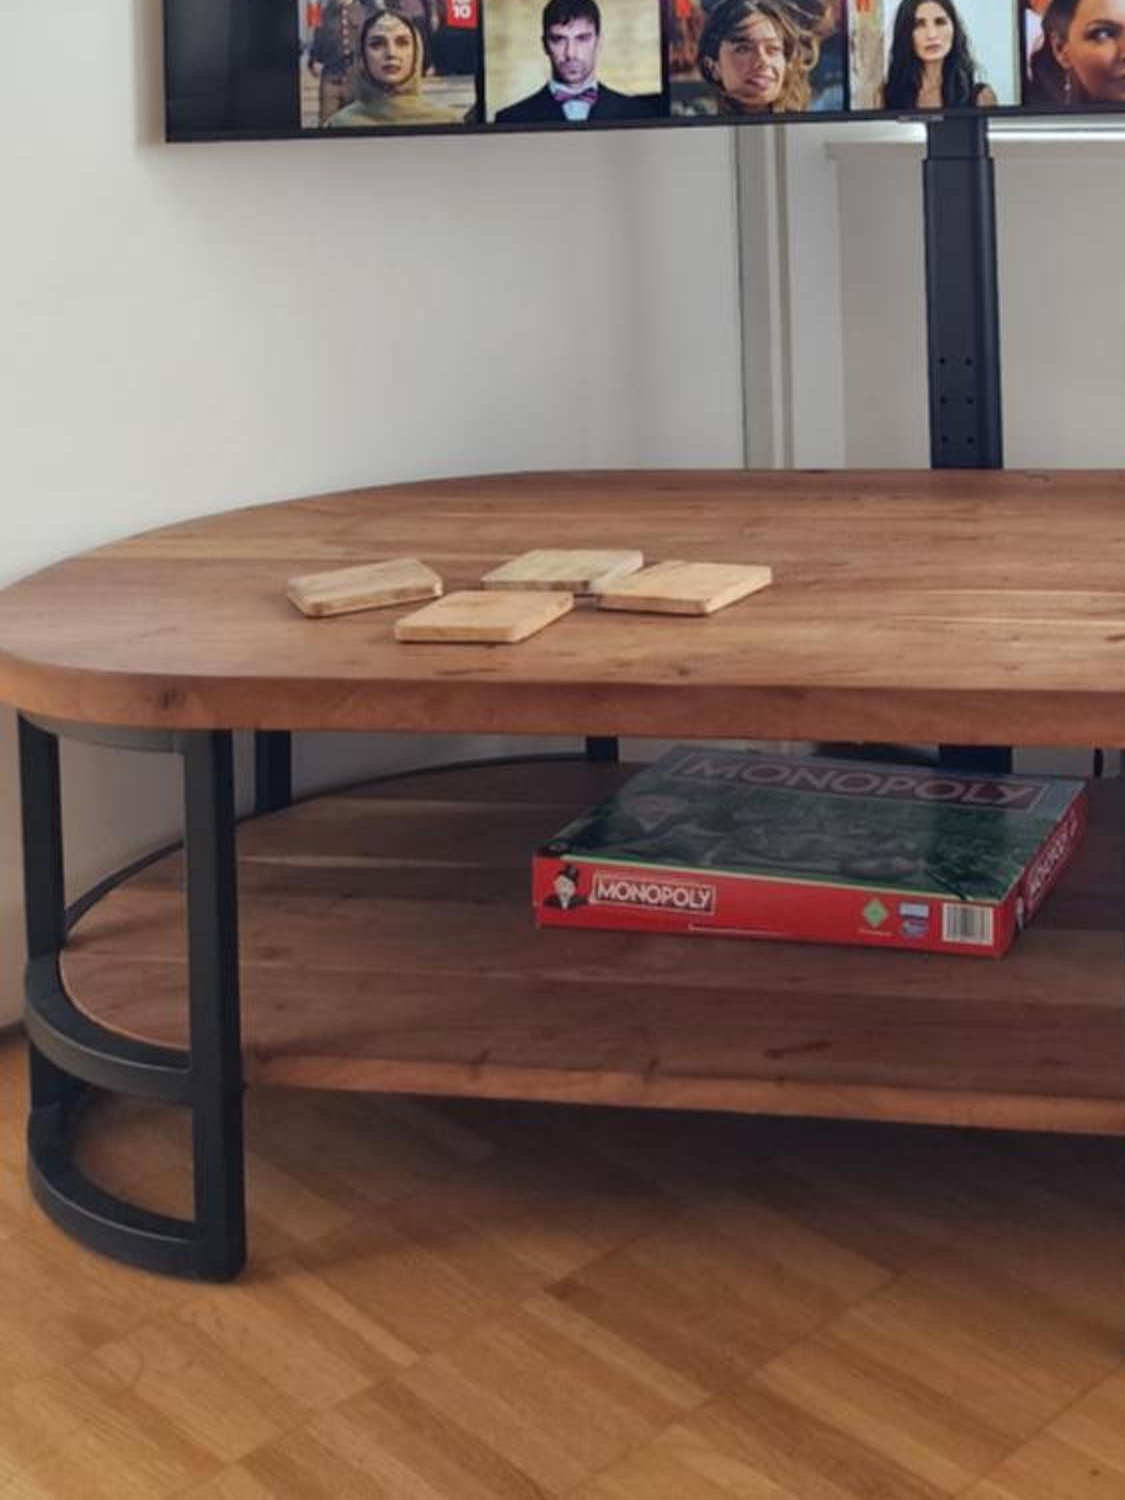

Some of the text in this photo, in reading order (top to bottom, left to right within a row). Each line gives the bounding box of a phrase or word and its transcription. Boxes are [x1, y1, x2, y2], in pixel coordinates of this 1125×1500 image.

[452, 4, 472, 20] 10
[679, 757, 1034, 806] MONOPOLY
[597, 879, 713, 911] MONOPOLY
